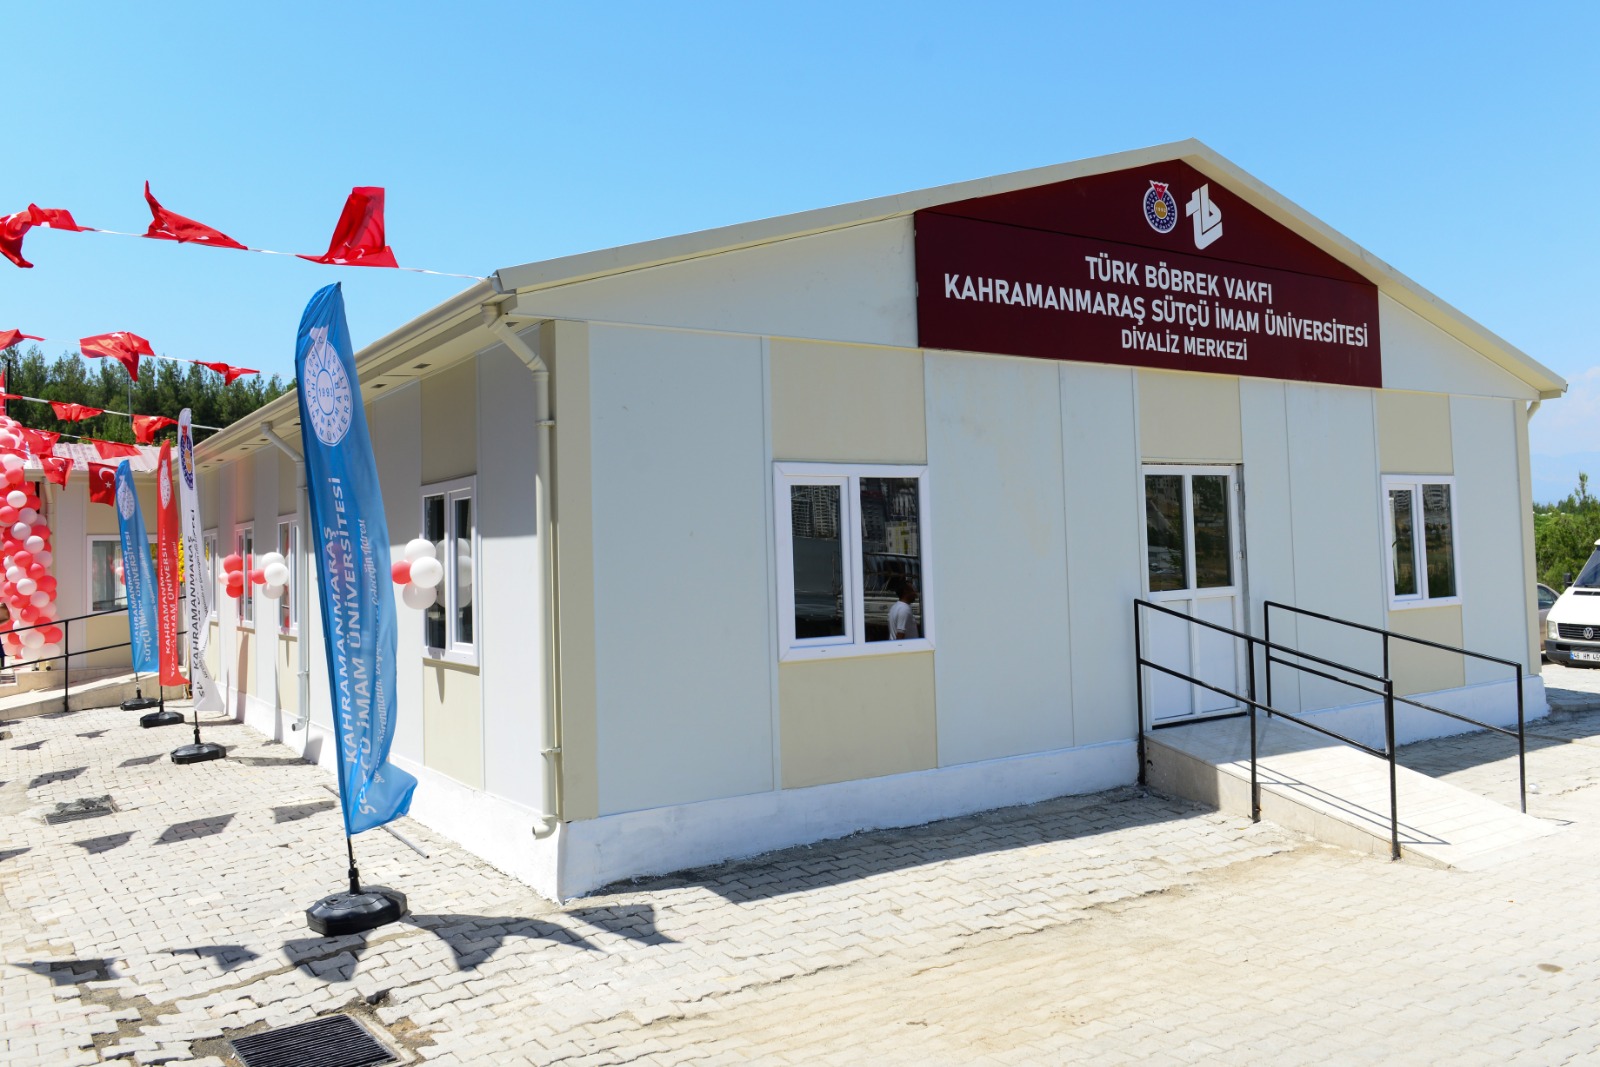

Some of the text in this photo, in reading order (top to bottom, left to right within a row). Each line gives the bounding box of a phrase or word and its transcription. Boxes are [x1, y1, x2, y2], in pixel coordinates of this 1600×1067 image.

[944, 273, 1368, 348] KAHRAMANMARAŞ SÜTÇÜ İMAM ÜNİVERSİTESİ
[1085, 252, 1272, 304] TÜRK BÖBREK VAKFI
[1121, 326, 1248, 361] DİYALİZ MERKEZİ
[124, 531, 141, 597] ÜNİVERSİTESİ
[328, 477, 361, 649] ÜNİVERSİTESİ
[139, 630, 152, 662] SÜTÇÜ
[324, 526, 358, 763] KAHRAMANMARAŞ
[352, 657, 371, 729] İMAM
